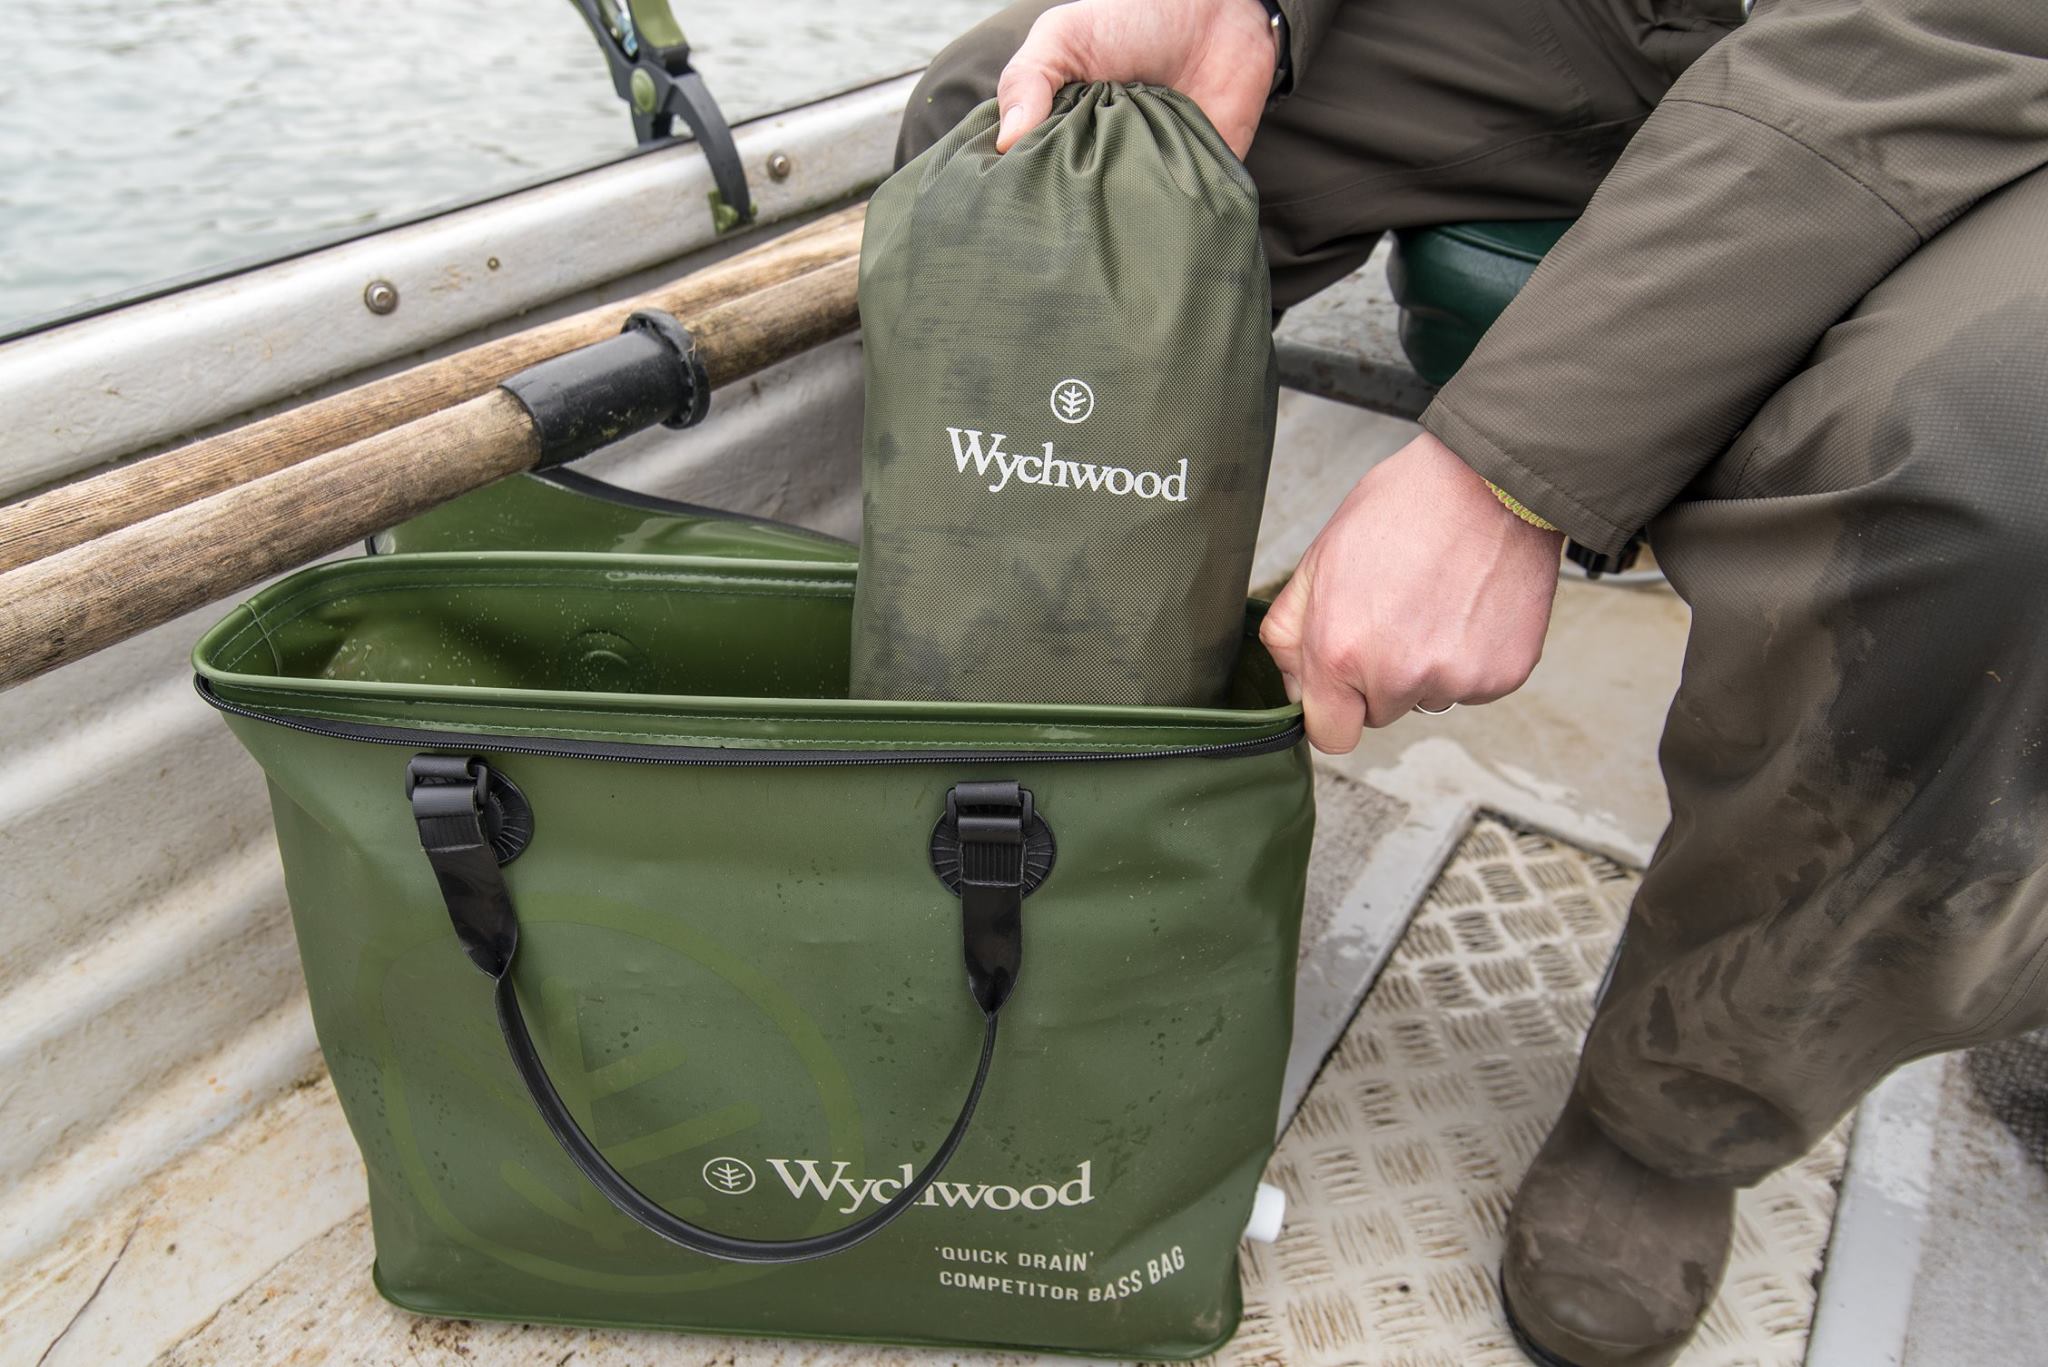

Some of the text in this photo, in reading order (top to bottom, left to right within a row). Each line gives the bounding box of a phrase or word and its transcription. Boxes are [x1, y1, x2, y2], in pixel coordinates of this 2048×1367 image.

[945, 426, 1188, 502] Wychwood
[939, 1244, 1186, 1302] COMPETITOR BASS BAG
